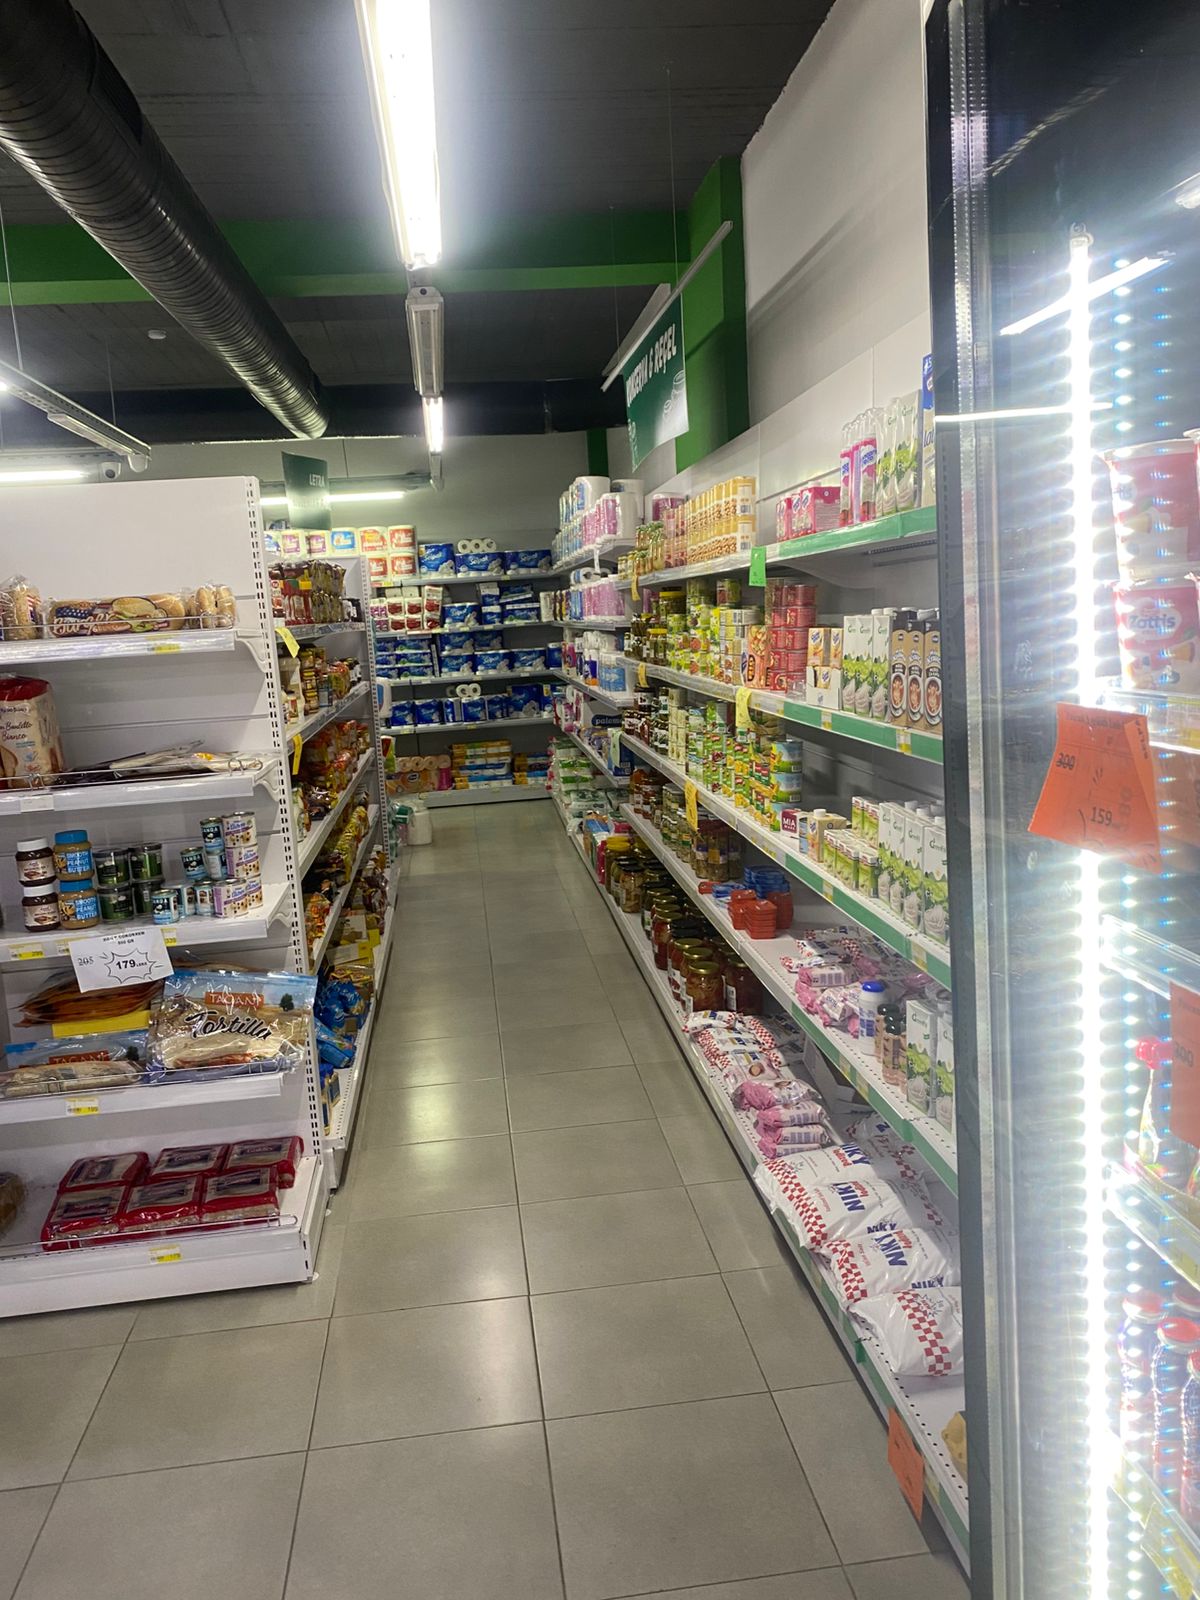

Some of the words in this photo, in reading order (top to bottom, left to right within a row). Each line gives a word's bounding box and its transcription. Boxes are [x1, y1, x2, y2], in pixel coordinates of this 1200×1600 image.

[1129, 613, 1176, 630] Zottis
[783, 817, 796, 828] MIA
[1090, 806, 1113, 826] 159
[184, 1009, 272, 1041] Tortilla
[874, 1233, 908, 1266] NIKY
